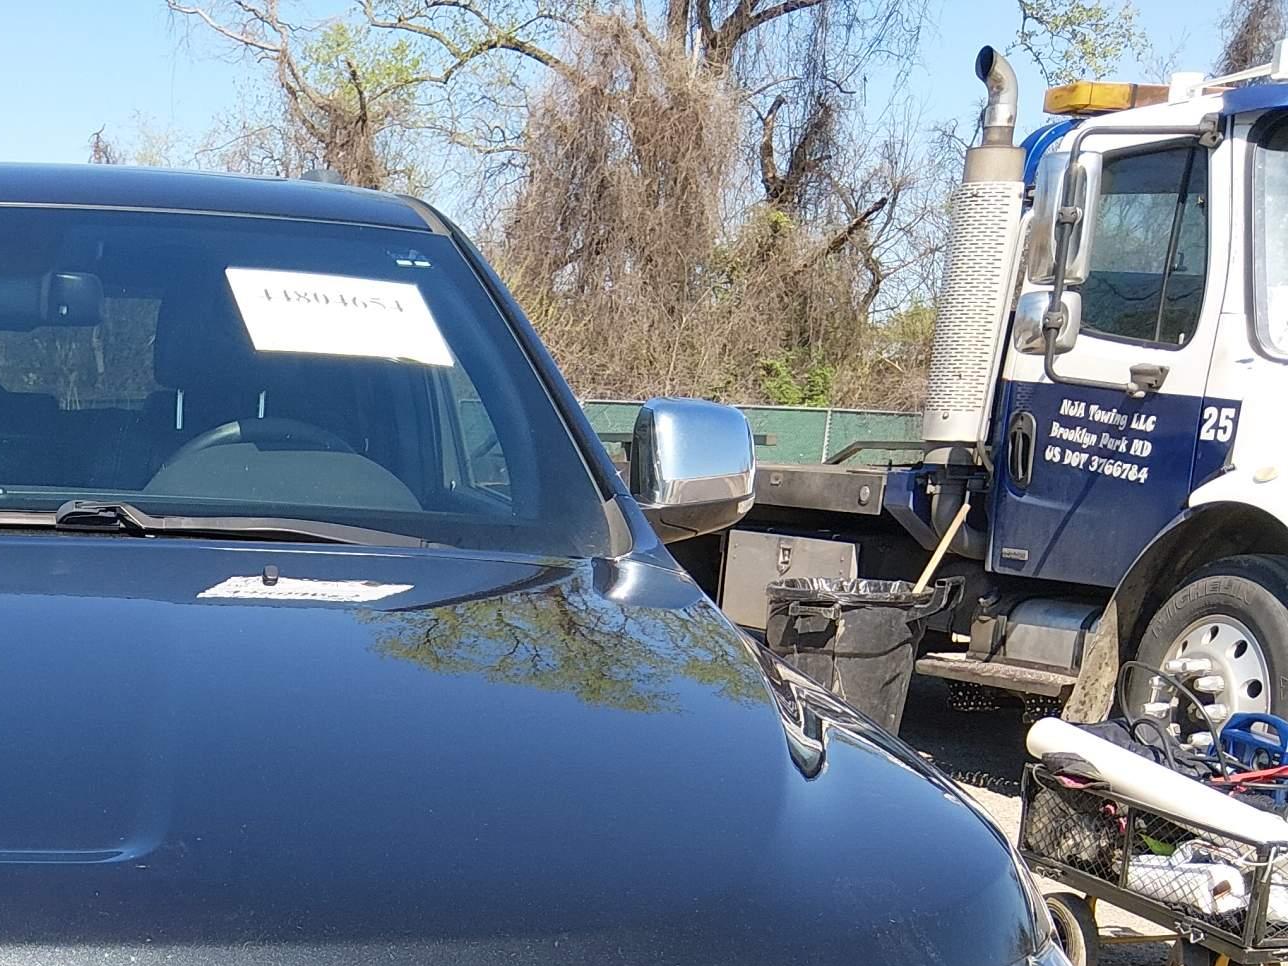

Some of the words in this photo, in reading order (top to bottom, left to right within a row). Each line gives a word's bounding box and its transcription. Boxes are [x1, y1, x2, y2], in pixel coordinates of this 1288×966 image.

[1059, 399, 1086, 418] NJA
[1088, 404, 1128, 430] Towing
[1130, 413, 1157, 432] LLC
[1199, 406, 1236, 442] 25
[1049, 421, 1098, 448] Brooklyn
[1098, 432, 1129, 453] Park
[1129, 438, 1153, 457] MD
[1045, 445, 1062, 463] US
[1062, 449, 1089, 469] DOT
[1089, 456, 1149, 483] 3766784
